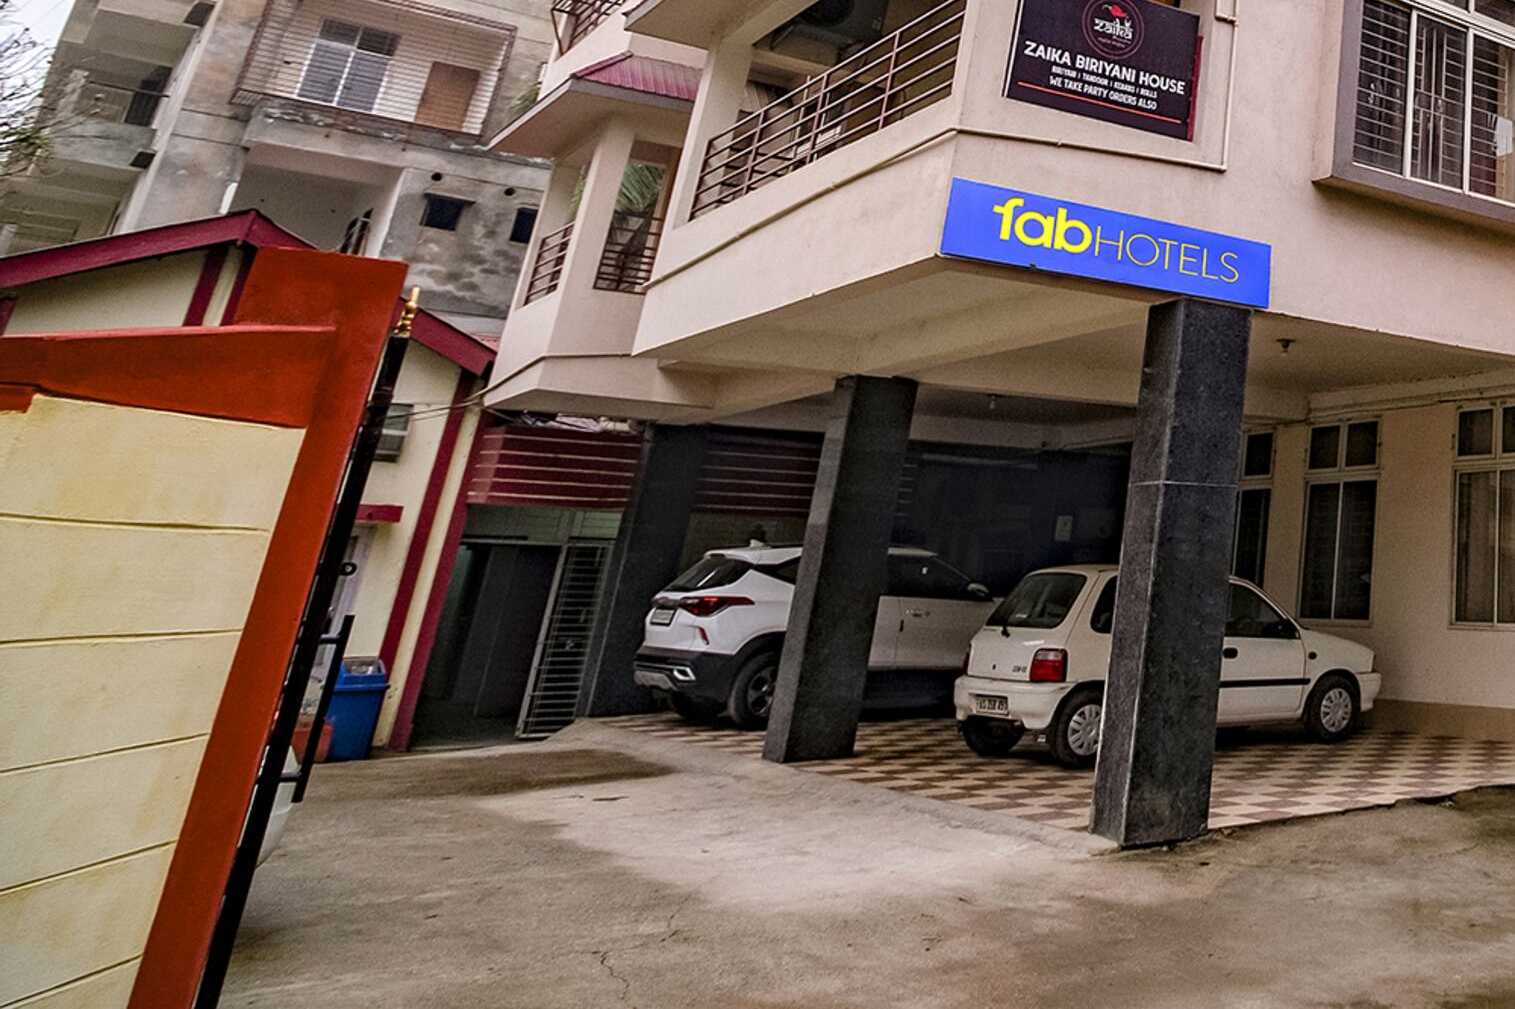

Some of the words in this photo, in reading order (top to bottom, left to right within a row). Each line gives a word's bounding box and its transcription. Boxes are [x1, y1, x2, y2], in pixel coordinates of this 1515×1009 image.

[1024, 40, 1072, 66] ZAIKA
[1075, 54, 1137, 83] BIRIYANI
[1139, 71, 1186, 95] HOUSE
[1049, 75, 1063, 87] WE
[1064, 78, 1083, 92] TAKE
[1083, 84, 1109, 98] PARTY
[1108, 90, 1137, 105] ORDERS
[1137, 98, 1158, 110] ALSO
